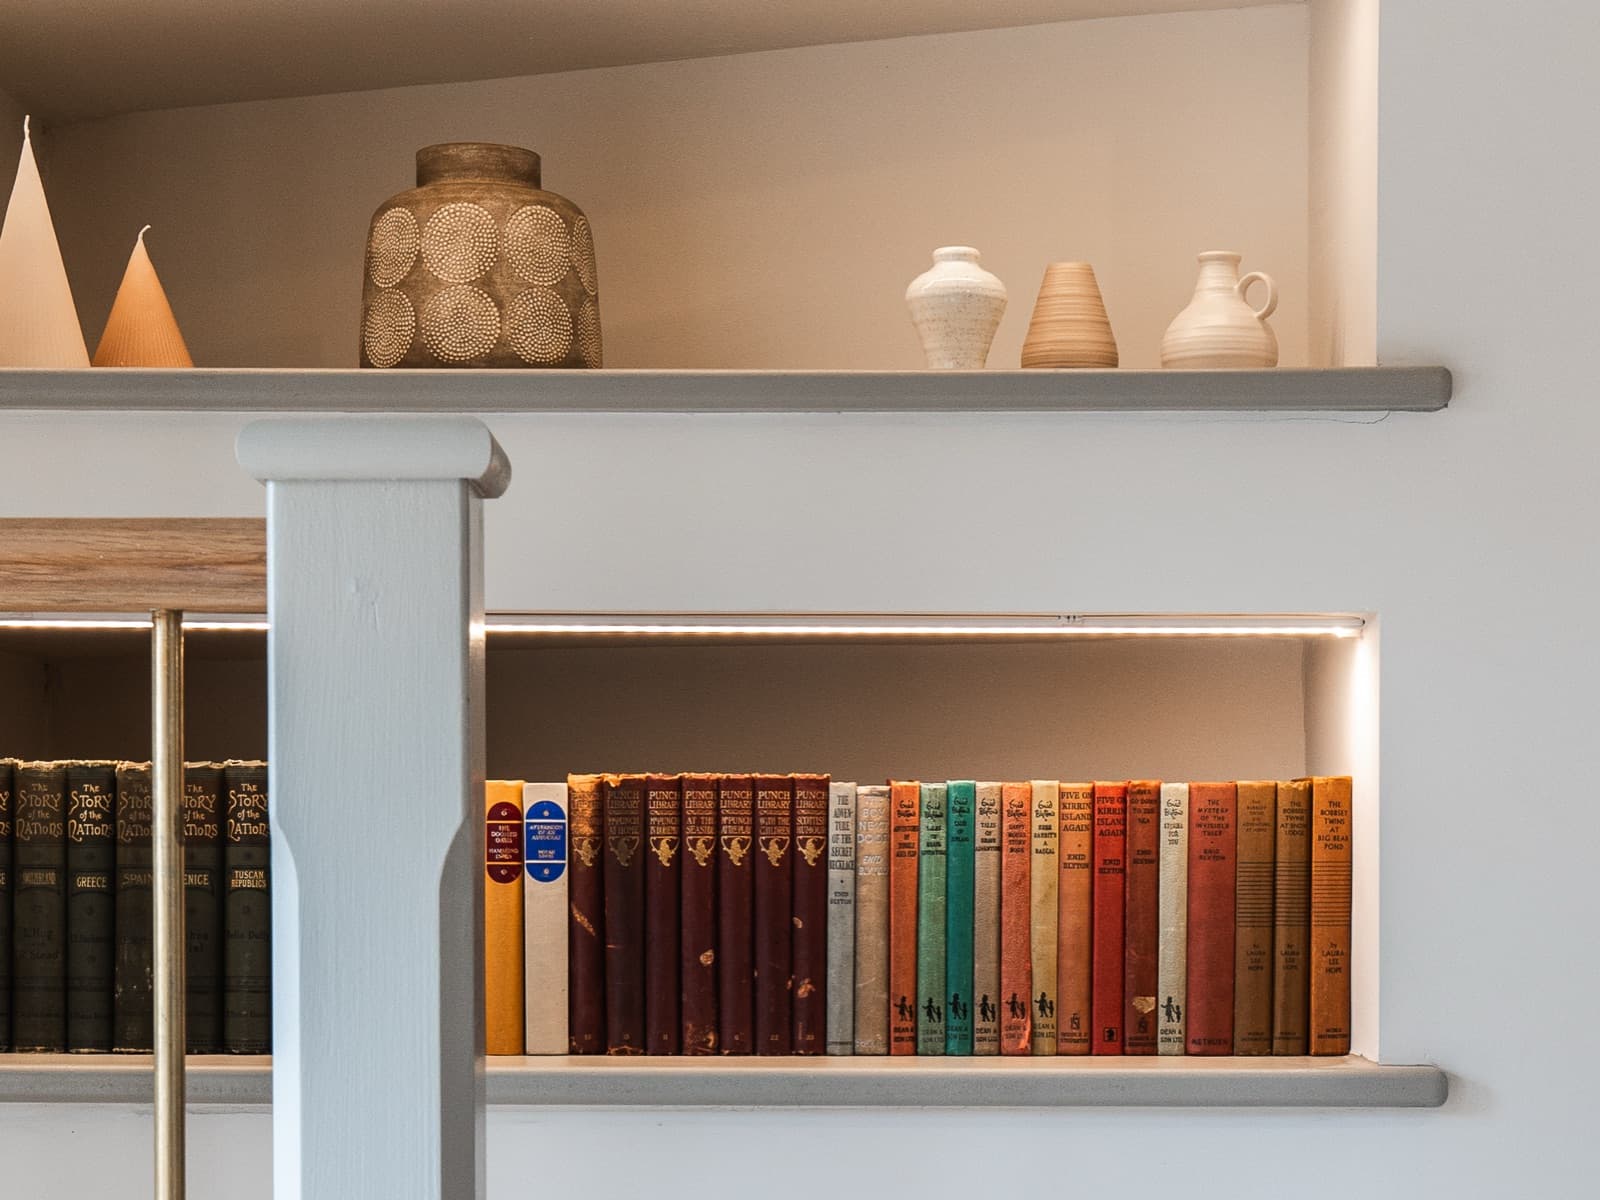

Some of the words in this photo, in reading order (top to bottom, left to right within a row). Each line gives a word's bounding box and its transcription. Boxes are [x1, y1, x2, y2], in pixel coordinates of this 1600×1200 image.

[83, 784, 100, 792] The
[188, 785, 203, 793] The
[241, 783, 257, 792] The
[721, 791, 752, 799] PUNCH
[758, 791, 790, 799] PUNCH
[69, 791, 114, 815] STORY
[184, 794, 217, 813] TORY
[758, 800, 790, 808] LIBRARY
[89, 810, 102, 819] the
[247, 810, 260, 819] the
[184, 873, 209, 886] ENICE
[235, 871, 264, 879] TUSCAN
[77, 876, 107, 888] GREECE
[231, 879, 267, 888] REPUBLICS
